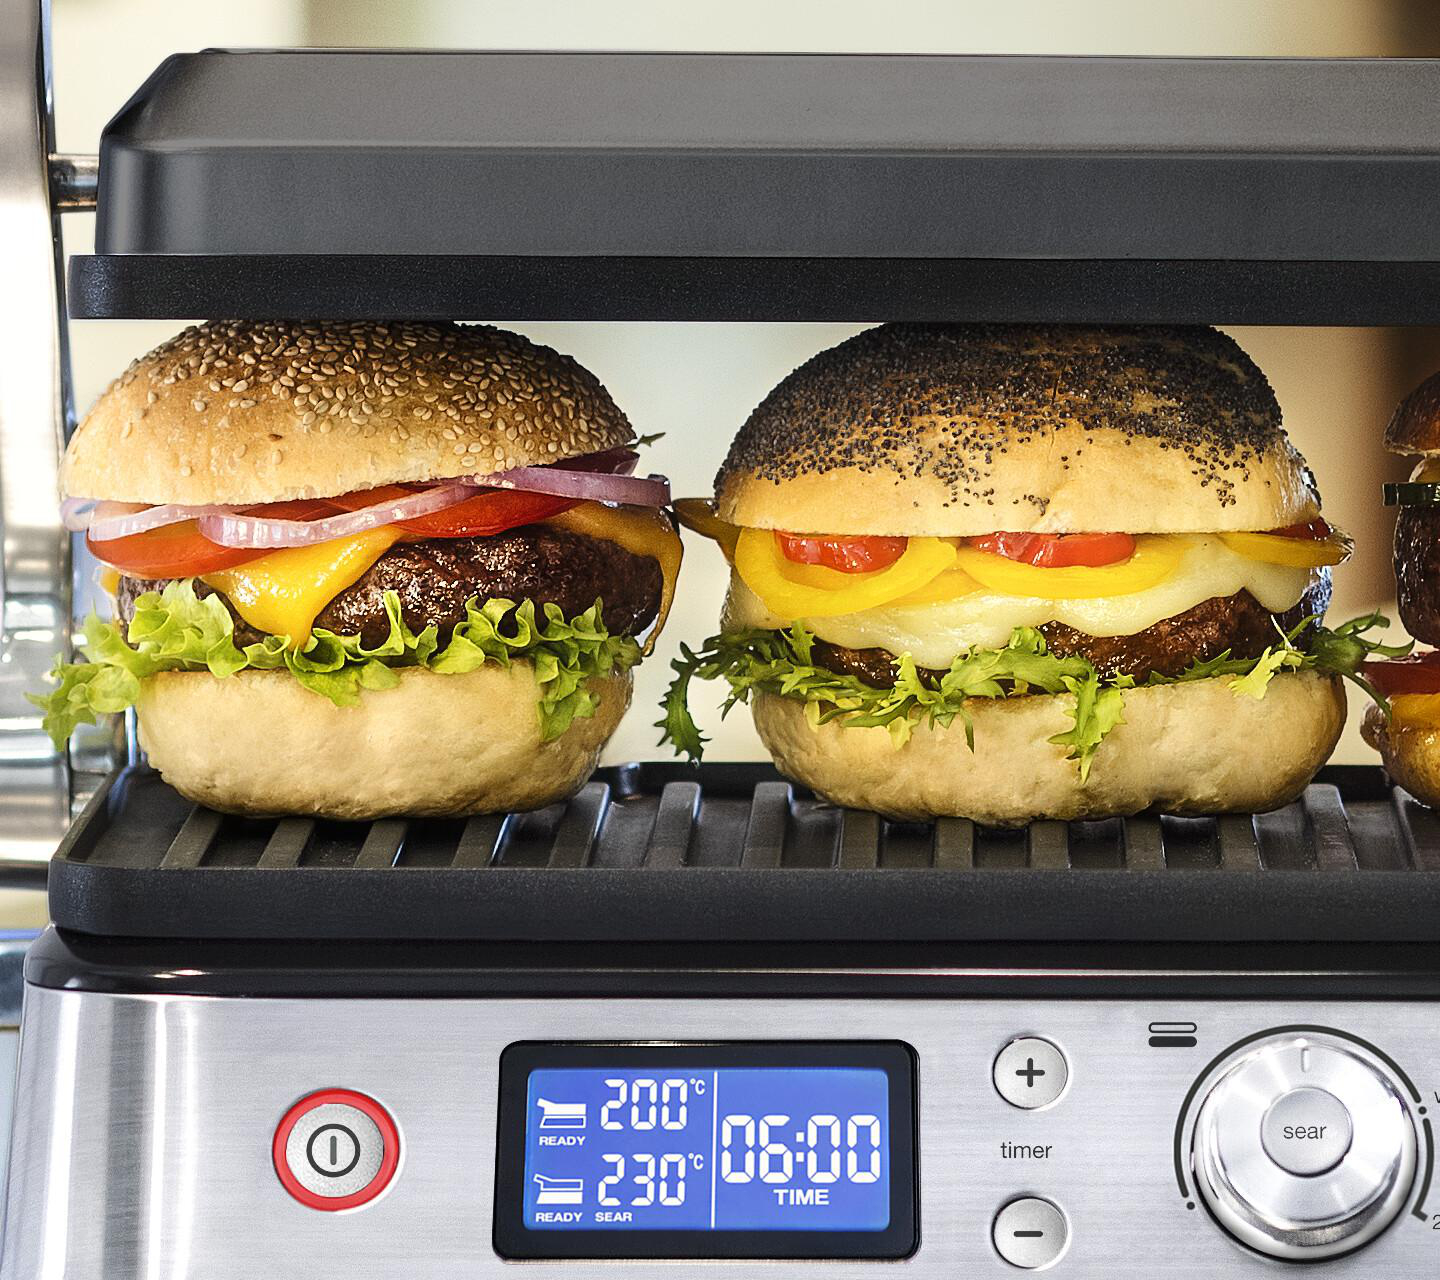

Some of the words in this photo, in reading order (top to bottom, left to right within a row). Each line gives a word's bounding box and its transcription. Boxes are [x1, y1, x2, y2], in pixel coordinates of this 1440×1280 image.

[1283, 1126, 1327, 1140] sear
[539, 1136, 586, 1146] READY
[721, 1114, 881, 1184] 06:00
[1000, 1141, 1053, 1159] timer
[773, 1188, 830, 1205] TIME
[535, 1212, 583, 1222] READY
[595, 1211, 633, 1223] SEAR
